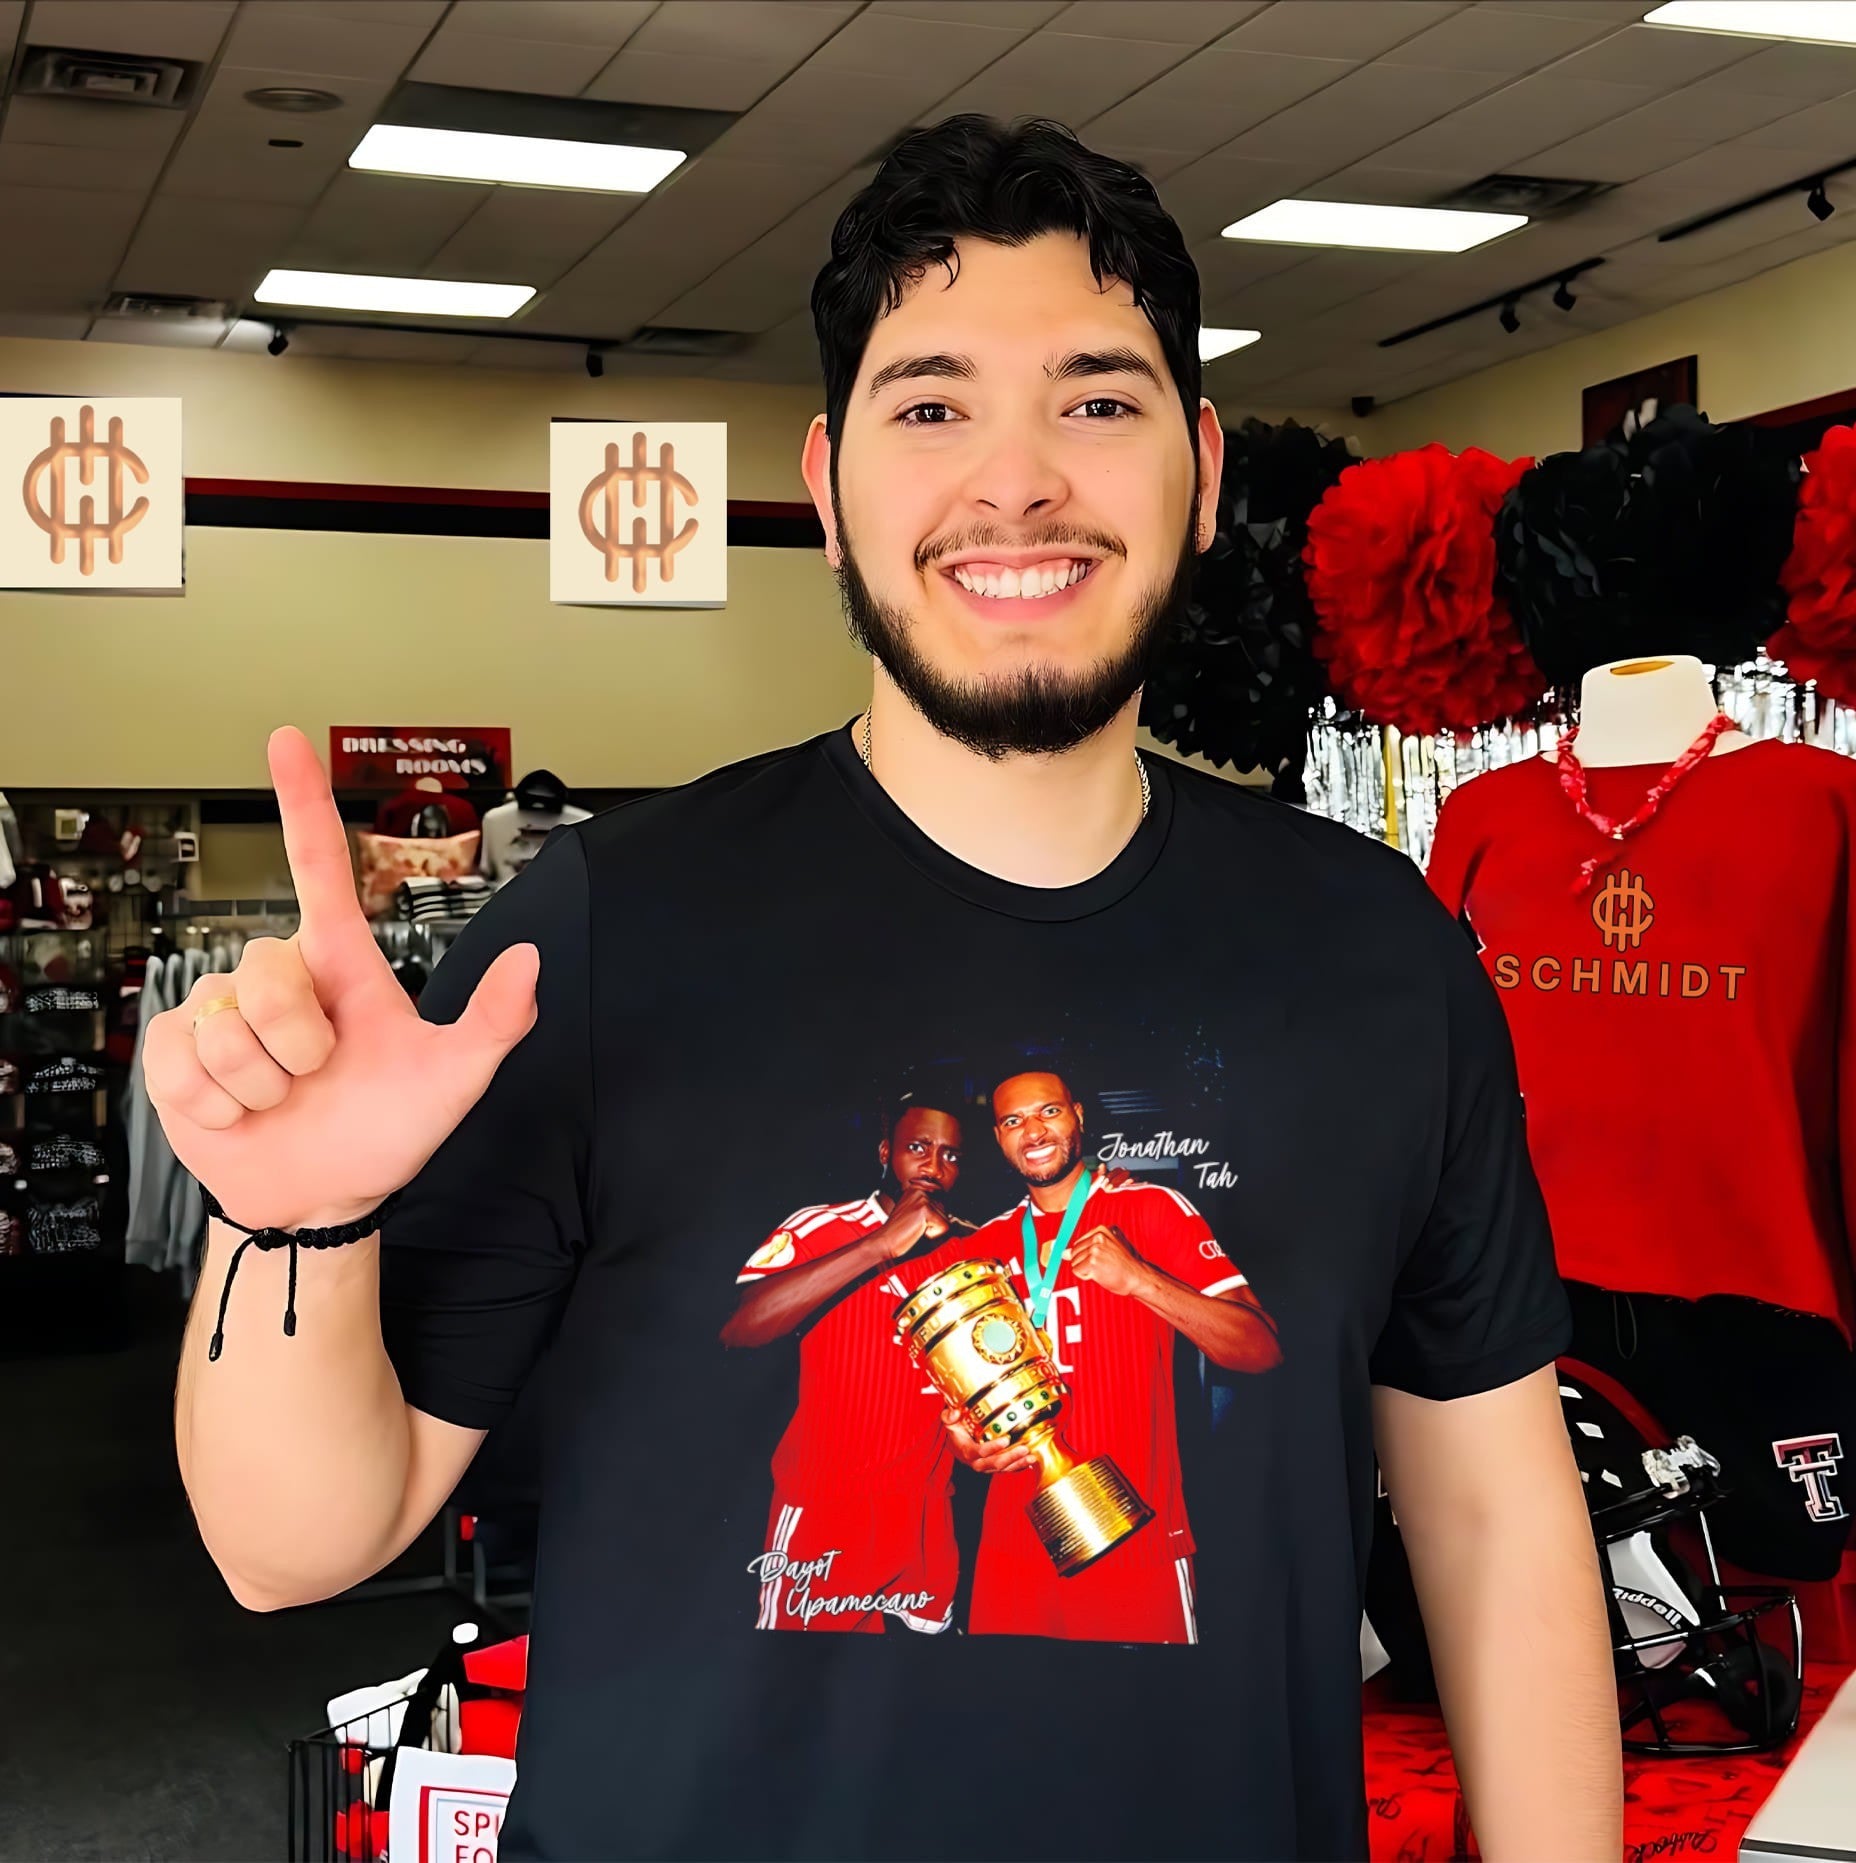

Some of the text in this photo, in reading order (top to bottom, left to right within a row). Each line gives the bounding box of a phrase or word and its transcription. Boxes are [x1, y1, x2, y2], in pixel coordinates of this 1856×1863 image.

[396, 758, 487, 775] ROOMS
[1494, 954, 1746, 1000] SCHMIDT
[1097, 1131, 1210, 1161] Jonathan
[1193, 1161, 1239, 1189] Tah
[747, 1549, 842, 1592] Dayot
[785, 1587, 935, 1625] Upamecano
